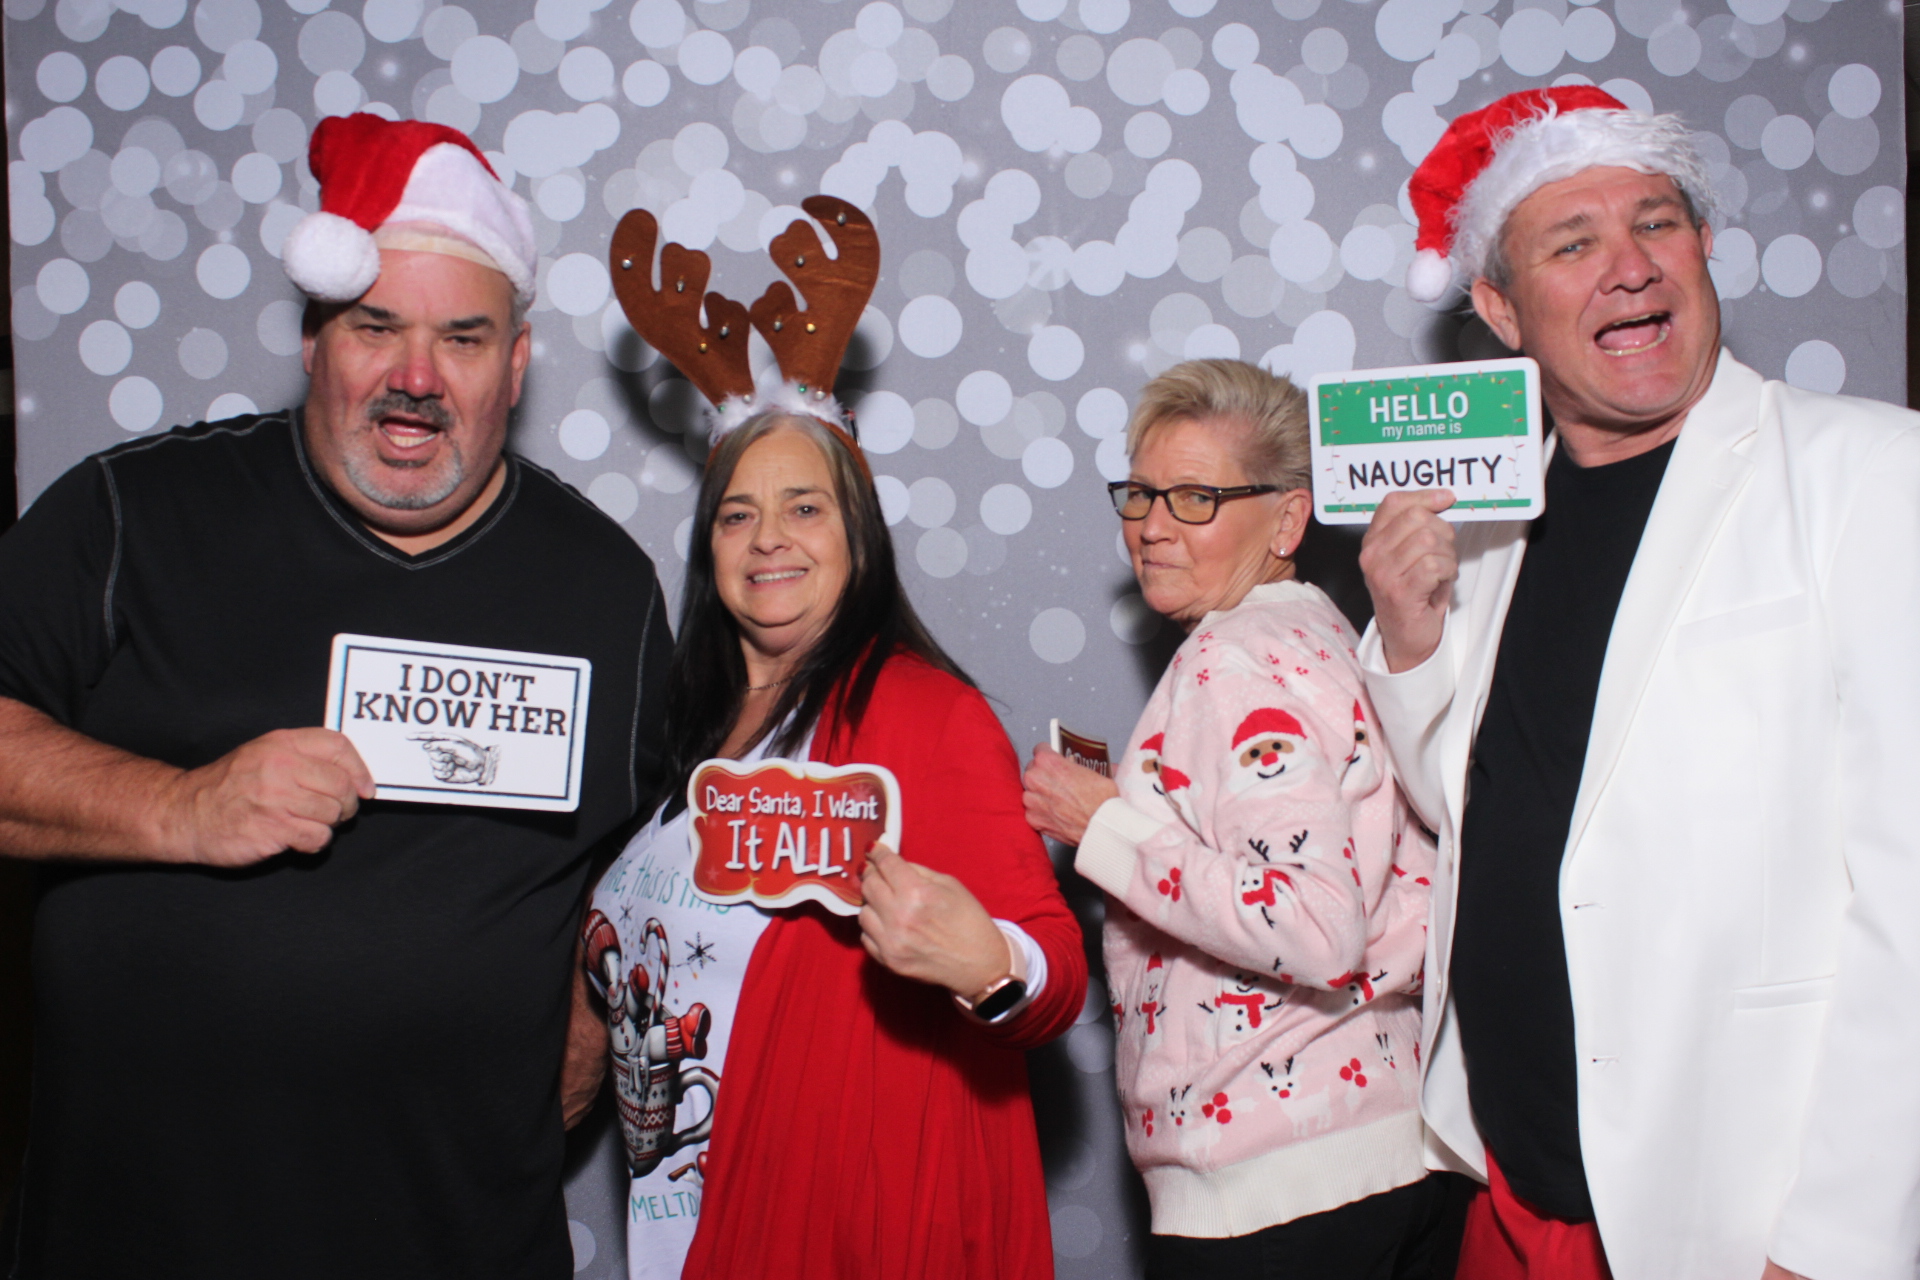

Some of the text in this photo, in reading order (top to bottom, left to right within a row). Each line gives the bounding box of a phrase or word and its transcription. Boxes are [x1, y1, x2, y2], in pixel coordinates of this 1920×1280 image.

[1369, 390, 1469, 423] HELLO
[1382, 419, 1462, 440] my name is
[1349, 454, 1502, 490] NAUGHTY
[399, 663, 535, 702] I DON'T
[353, 691, 567, 736] KNOW HER
[706, 785, 879, 820] Dear Santa, I Want
[725, 819, 852, 879] It ALL!
